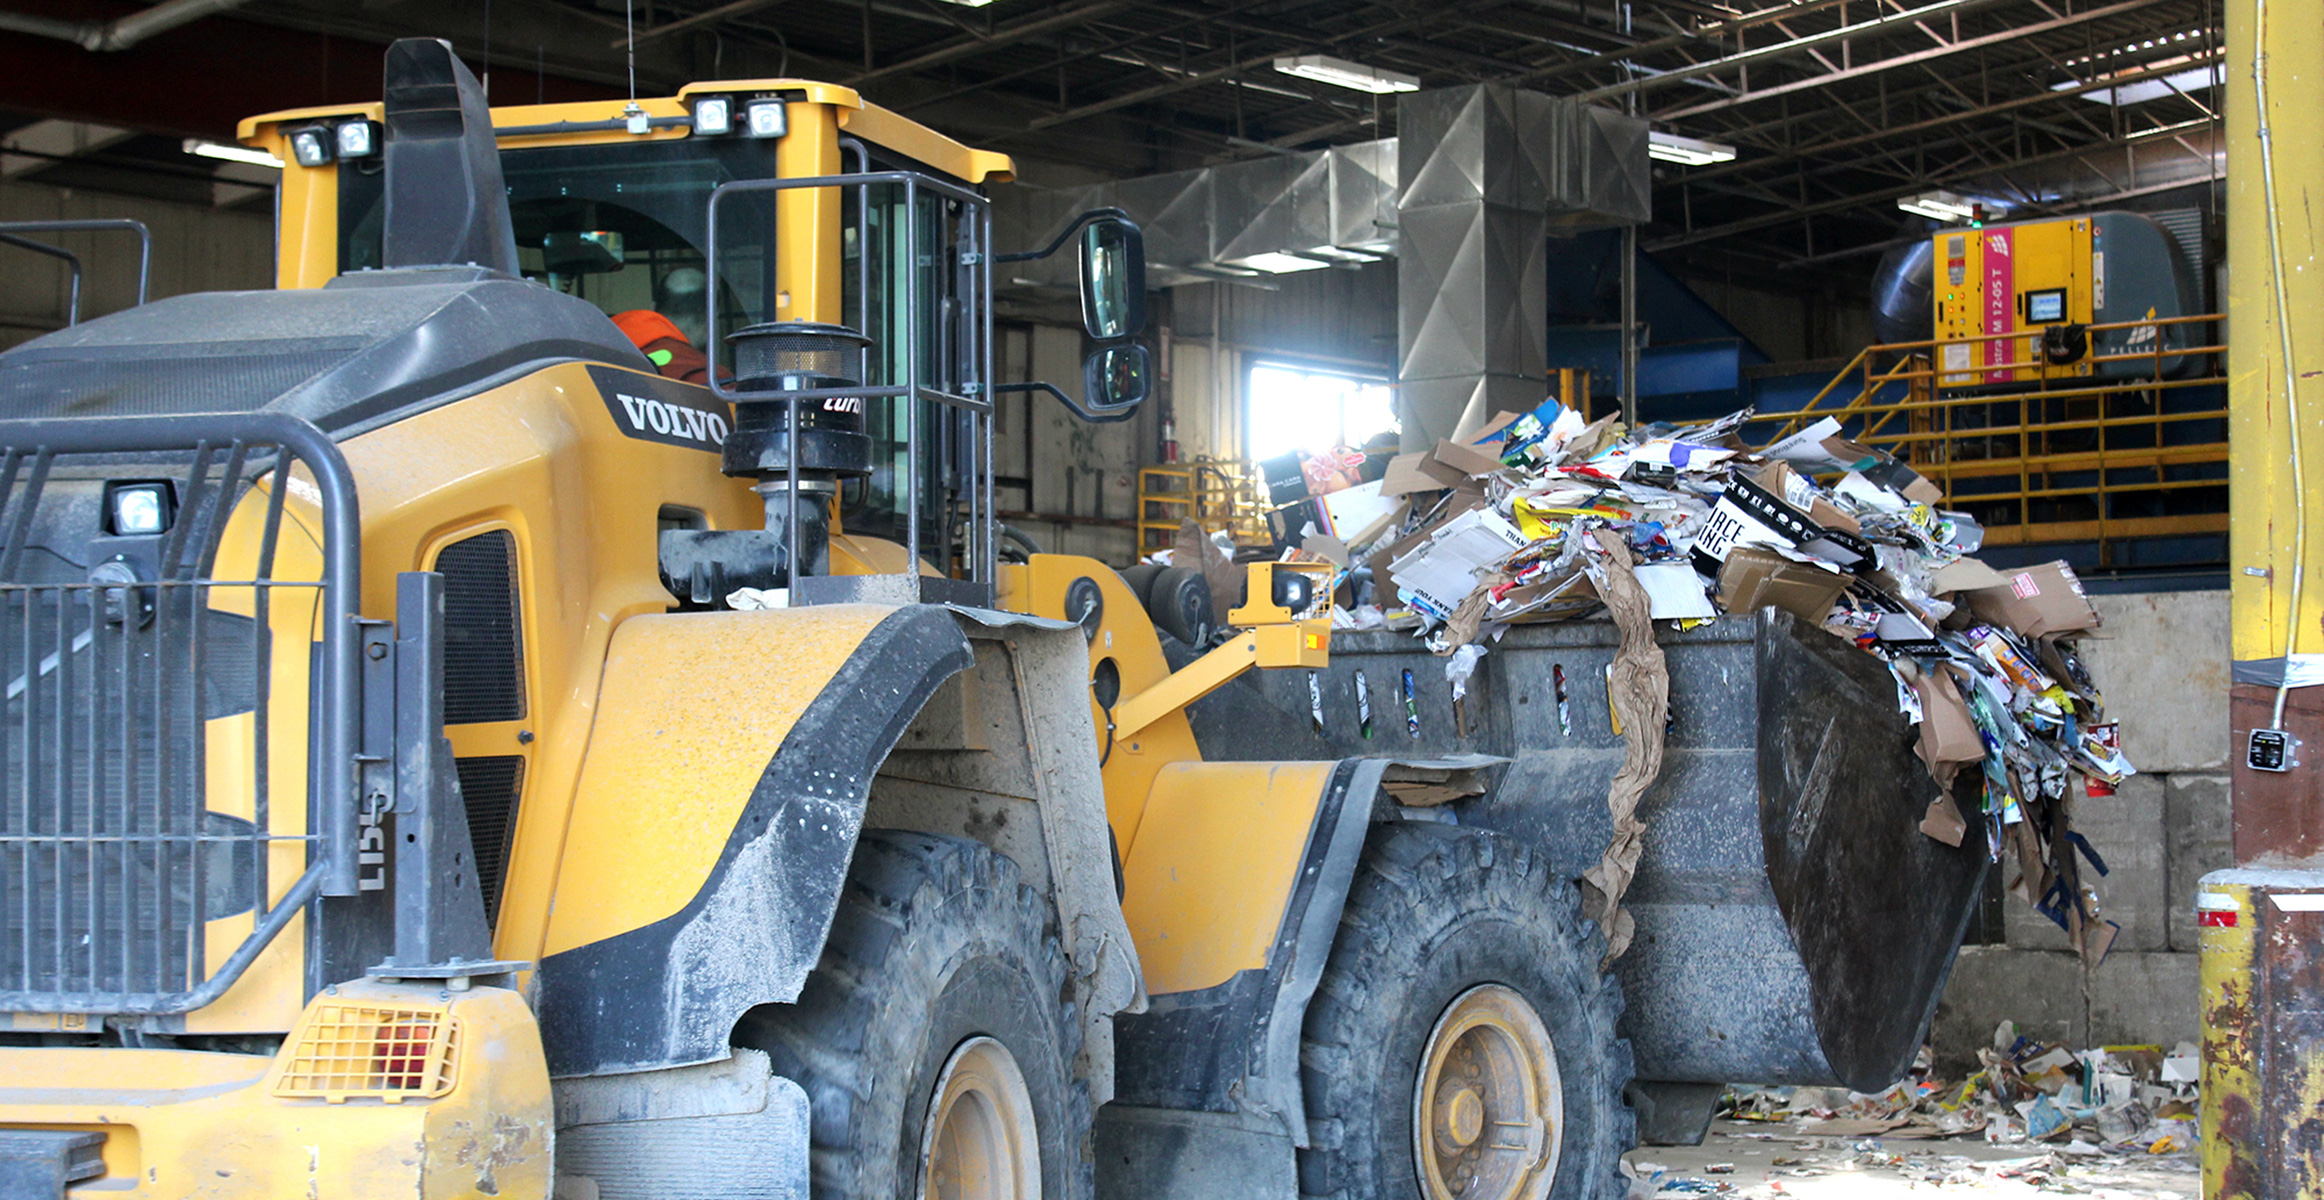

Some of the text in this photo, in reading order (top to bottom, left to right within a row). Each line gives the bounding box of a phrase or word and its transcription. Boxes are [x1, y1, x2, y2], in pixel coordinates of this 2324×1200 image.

[1992, 268, 2003, 378] Mistra M 12-05 T
[616, 393, 729, 446] VOLVO
